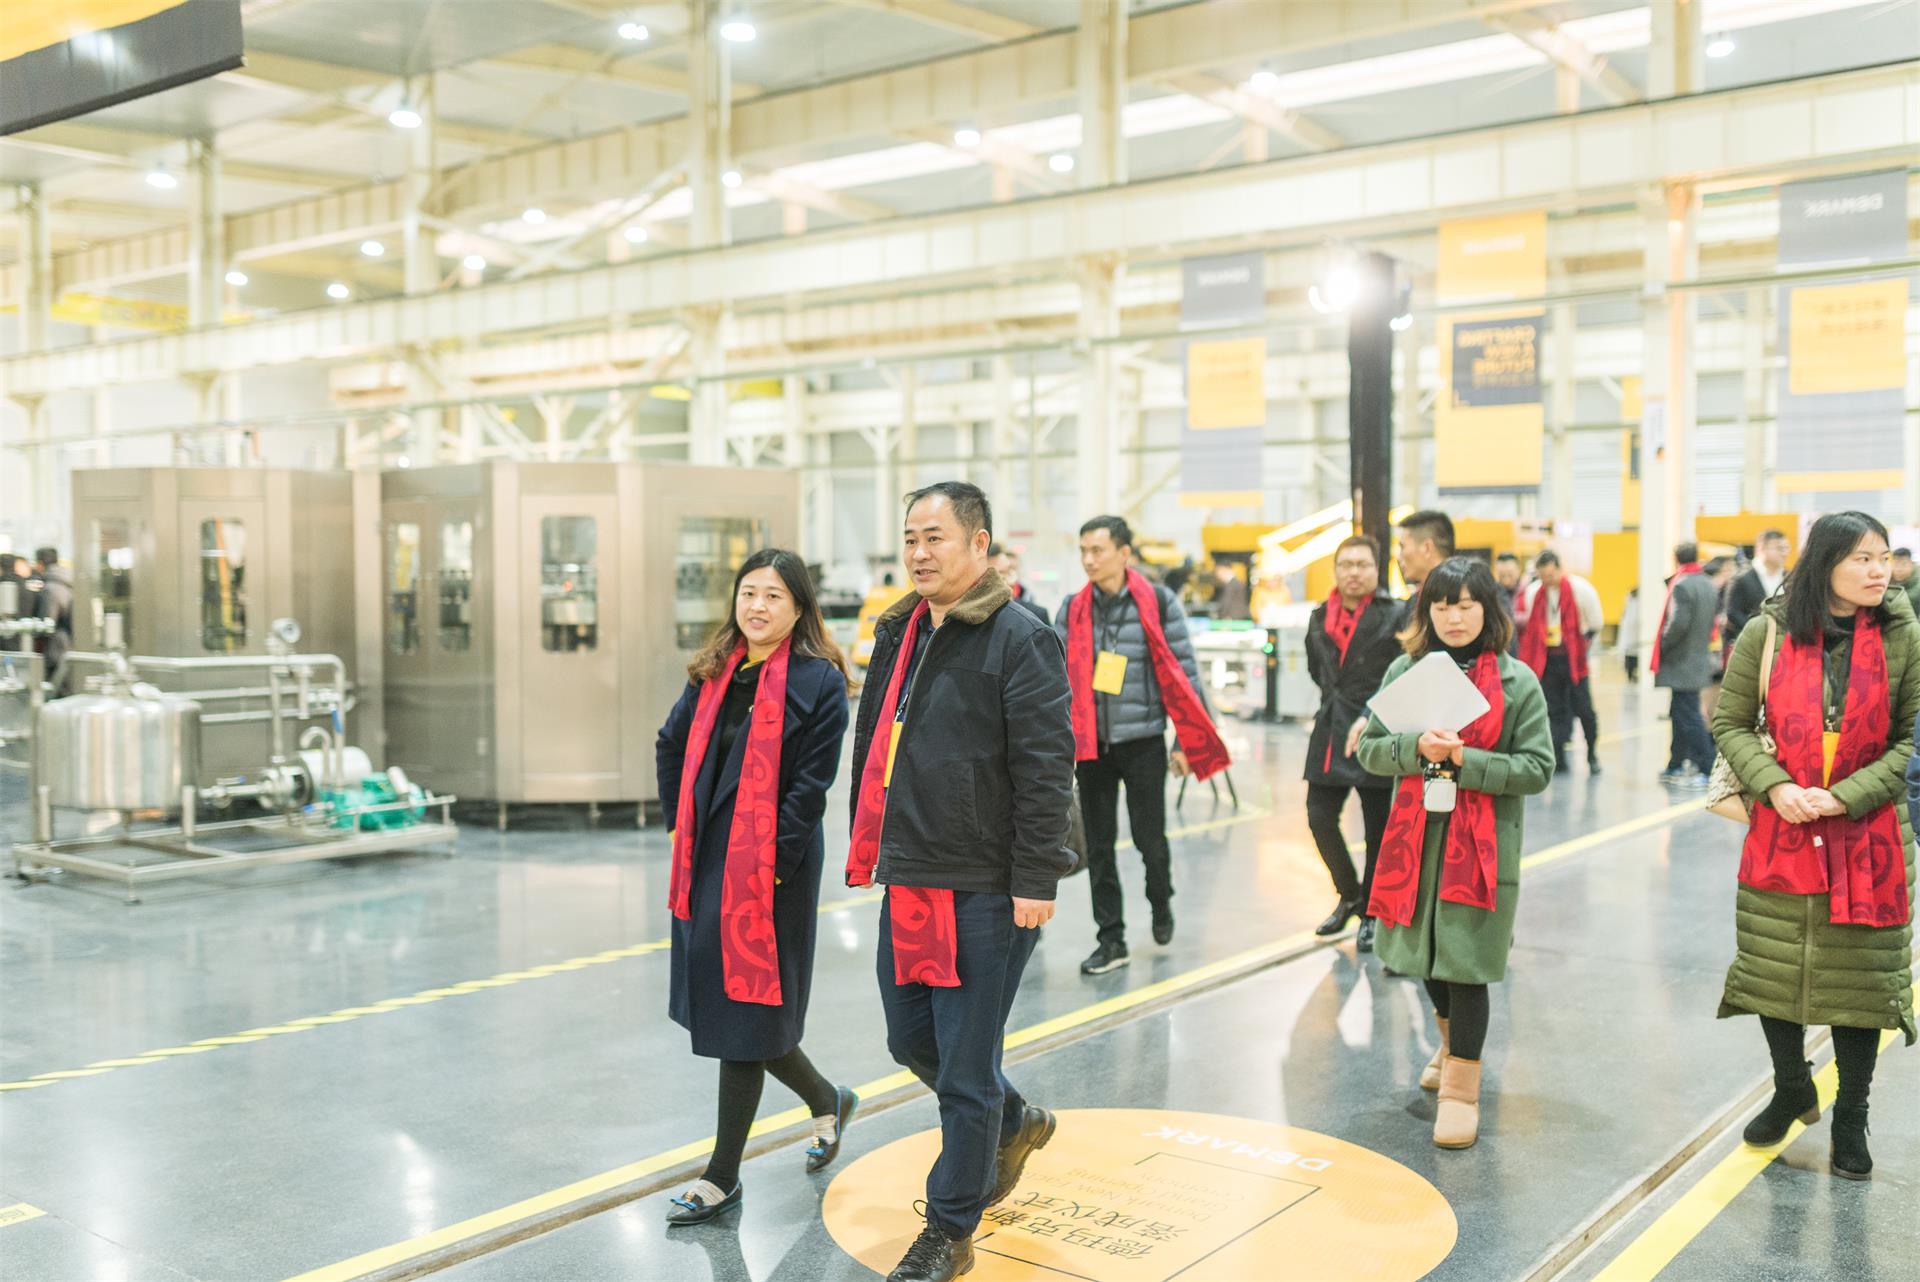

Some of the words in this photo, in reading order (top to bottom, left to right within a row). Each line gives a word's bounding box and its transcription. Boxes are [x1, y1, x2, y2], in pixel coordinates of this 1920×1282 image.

[1142, 1124, 1334, 1172] DEMARK
[1066, 1167, 1157, 1195] Opening
[1014, 1191, 1188, 1241] 落成仪式
[1156, 1190, 1229, 1212] Grand
